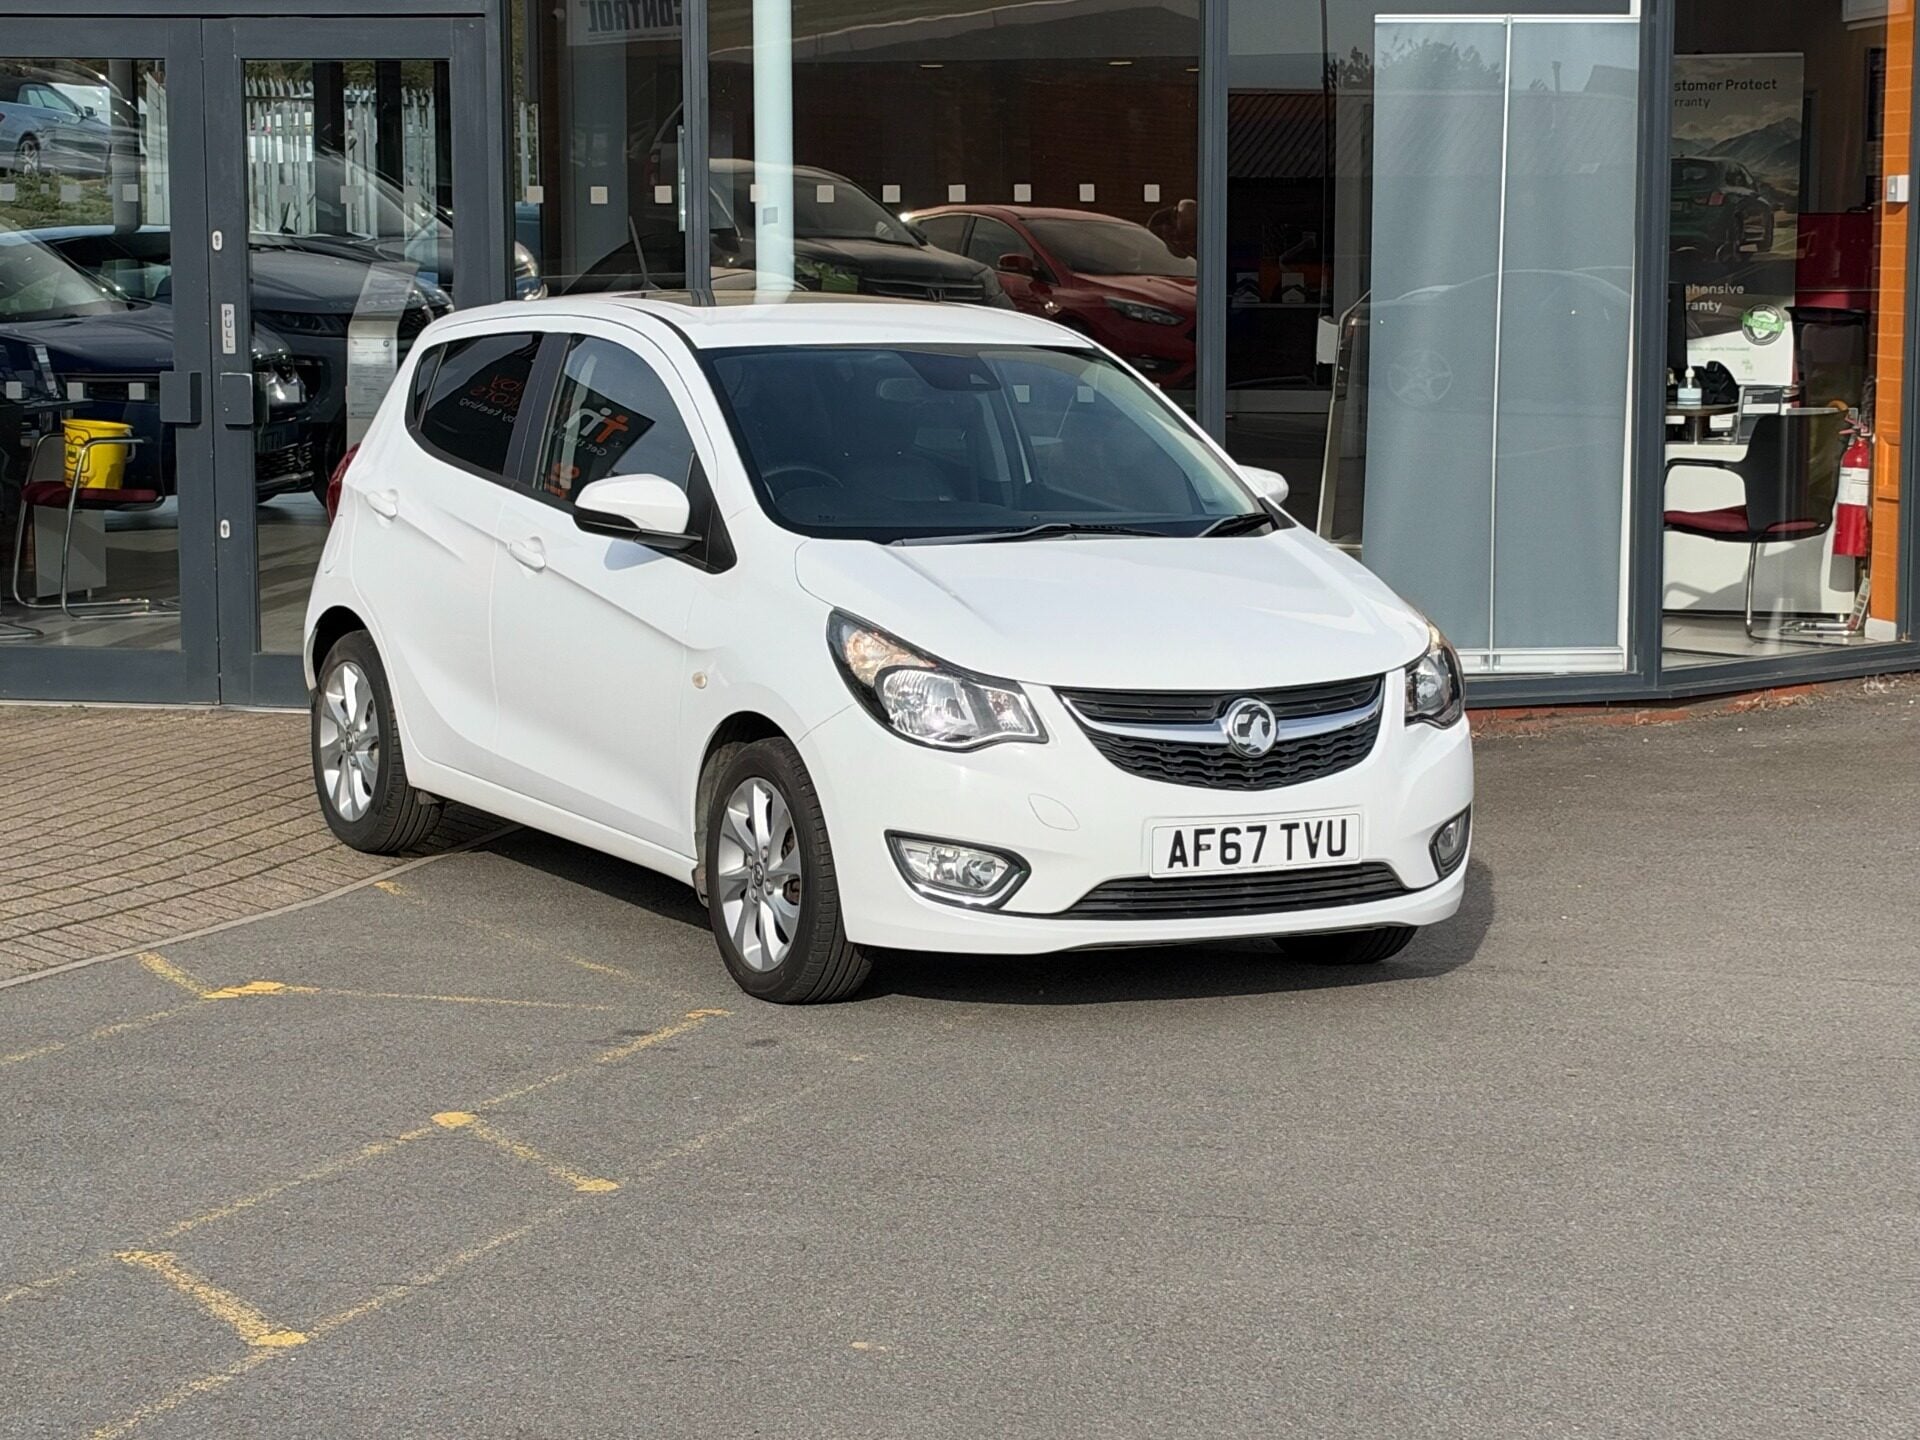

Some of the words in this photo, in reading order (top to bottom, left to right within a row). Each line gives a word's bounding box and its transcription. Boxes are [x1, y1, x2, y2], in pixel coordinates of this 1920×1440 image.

[1725, 78, 1777, 90] Protect
[224, 309, 233, 348] PULL
[1167, 825, 1267, 868] AF67
[1279, 818, 1347, 861] TVU
